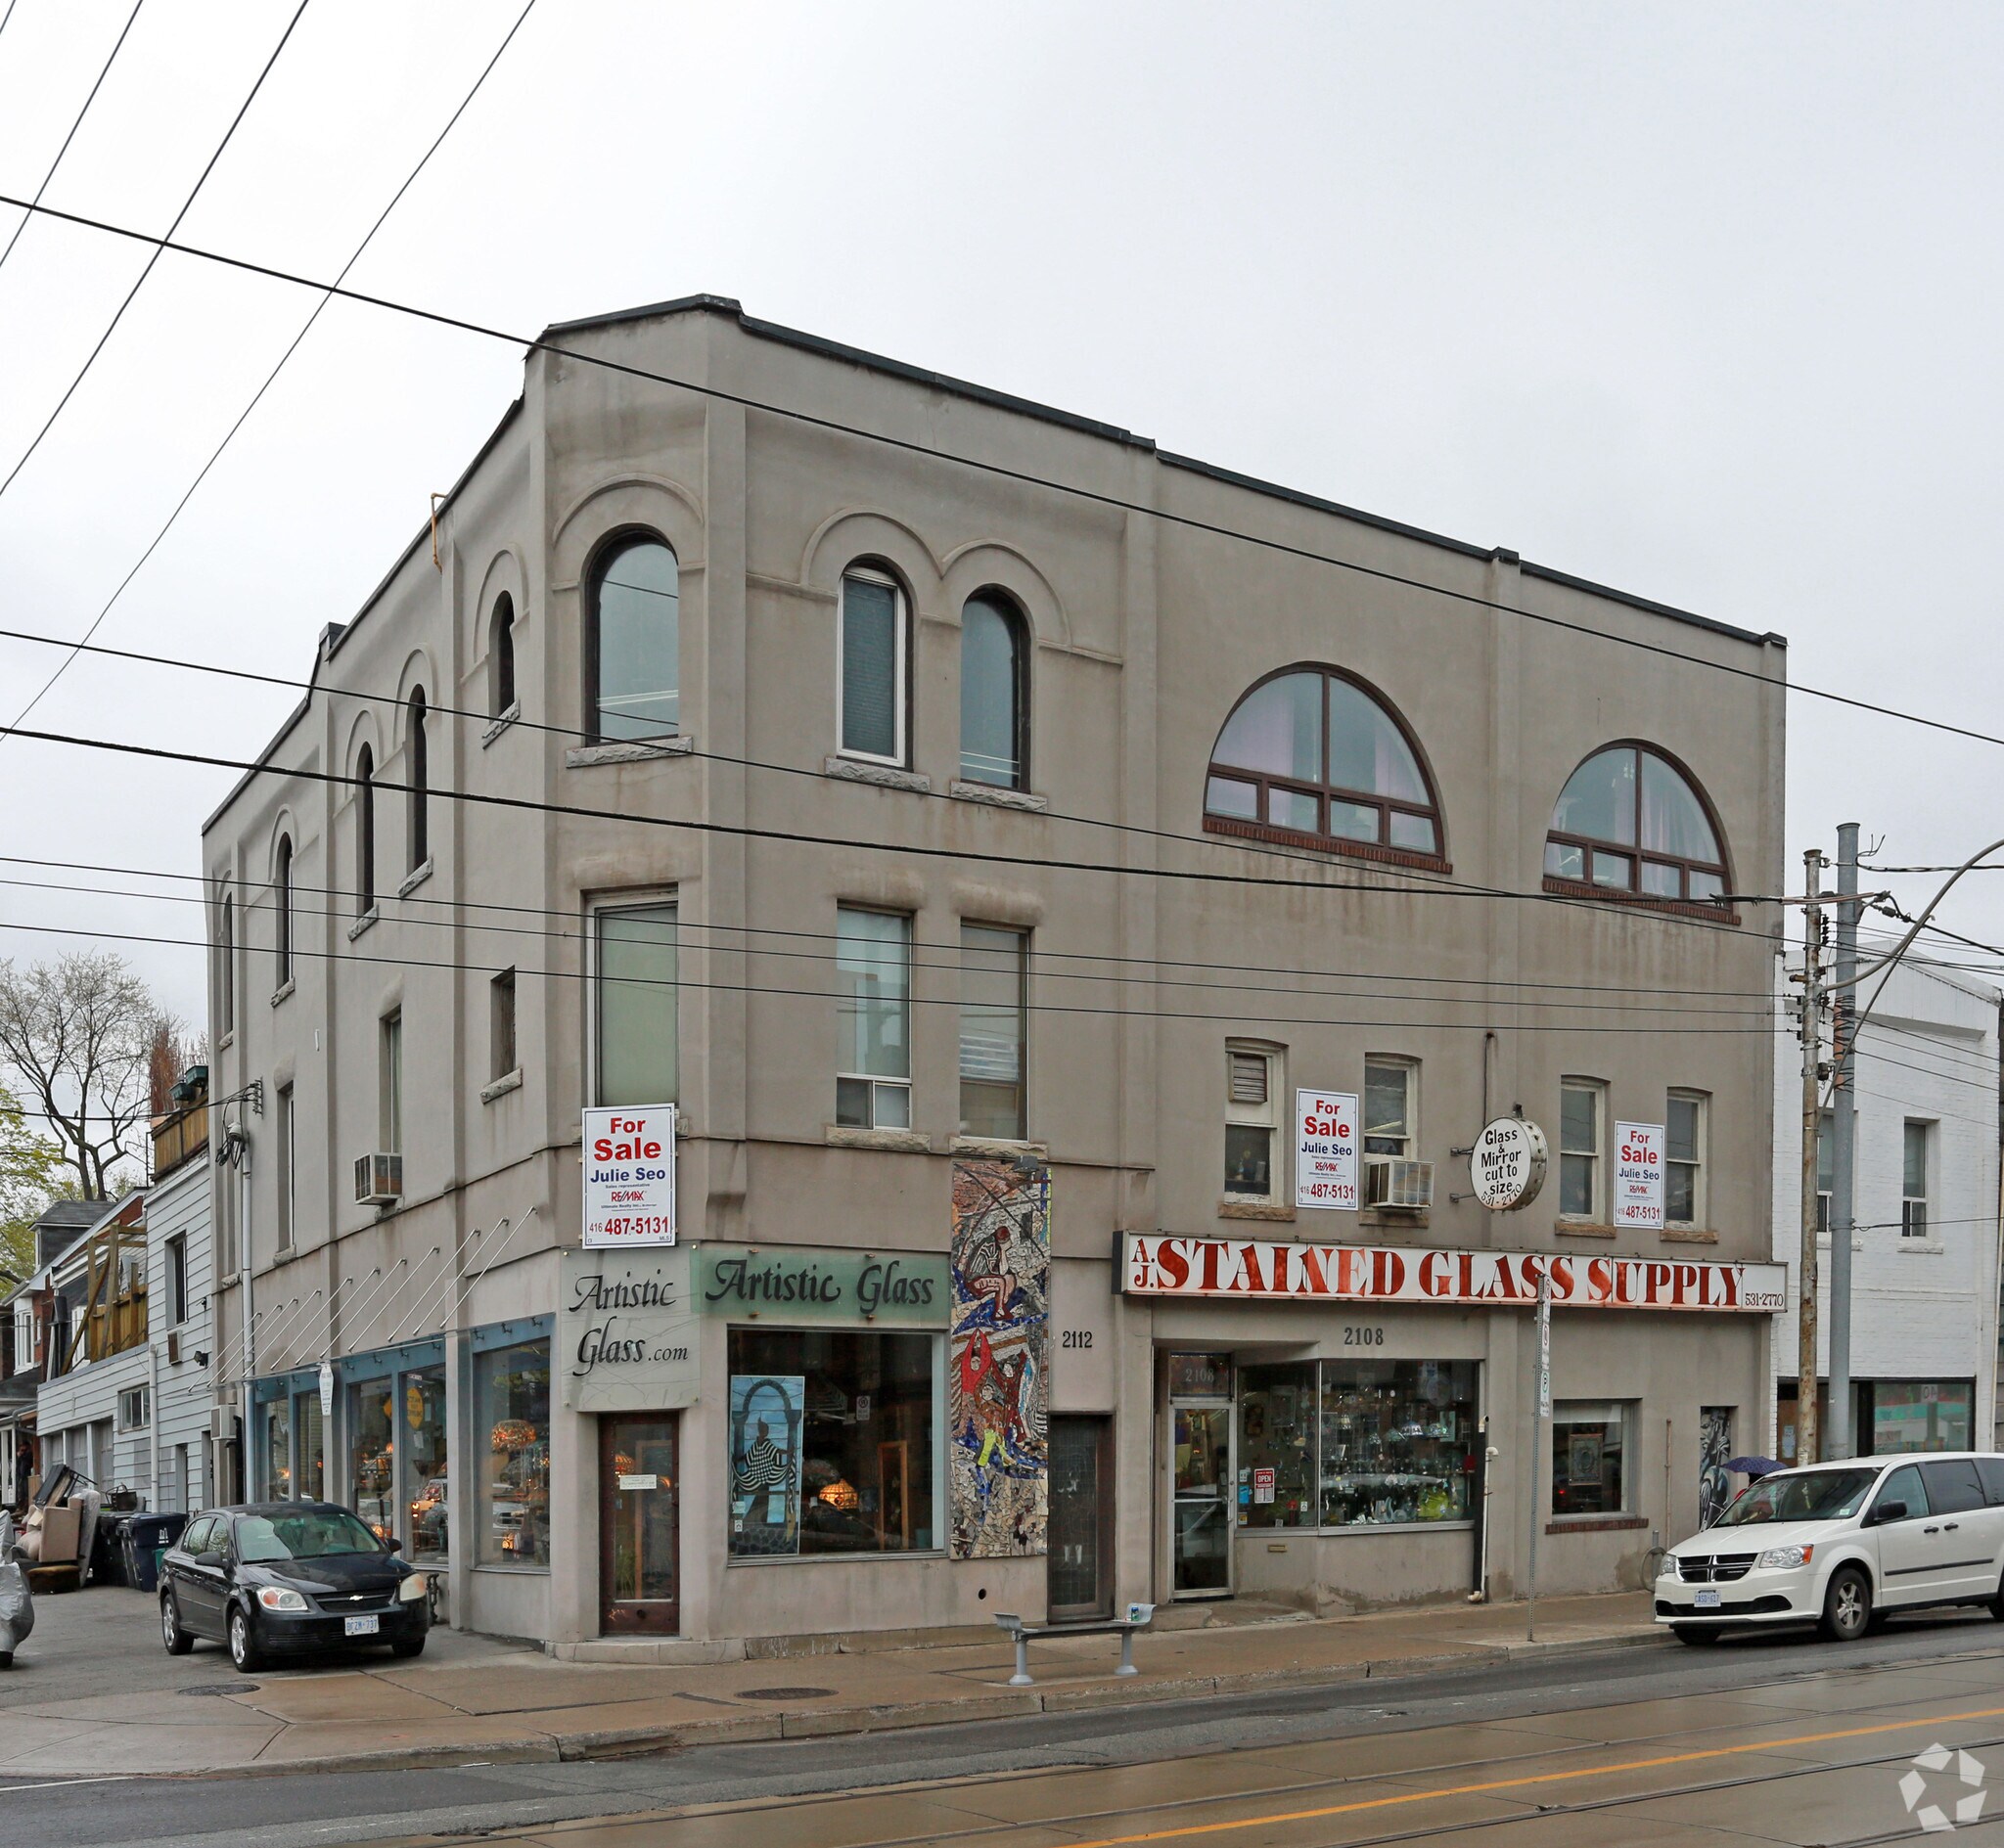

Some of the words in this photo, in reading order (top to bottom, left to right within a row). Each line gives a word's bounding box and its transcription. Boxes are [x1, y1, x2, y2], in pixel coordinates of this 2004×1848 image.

[1315, 1100, 1341, 1115] For
[611, 1117, 646, 1134] For
[1304, 1115, 1350, 1139] Sale
[1485, 1129, 1517, 1146] Glass
[1630, 1131, 1650, 1144] For
[594, 1137, 661, 1161] Sale
[1301, 1142, 1329, 1154] Julie
[1332, 1144, 1352, 1156] Seo
[1499, 1144, 1505, 1153] &
[1621, 1145, 1658, 1164] Sale
[1481, 1150, 1521, 1168] Mirror
[590, 1168, 630, 1183] Julie
[635, 1167, 665, 1181] Seo
[1485, 1165, 1503, 1181] cut
[1507, 1164, 1518, 1177] to
[1619, 1167, 1640, 1179] Julie
[1643, 1169, 1660, 1180] Seo
[611, 1190, 644, 1202] RE/MAX
[1311, 1183, 1354, 1199] 487-5131
[1490, 1181, 1513, 1195] size
[1625, 1205, 1660, 1220] 487-5131
[589, 1222, 603, 1233] 416
[605, 1216, 668, 1235] 487-5131
[1157, 1238, 1405, 1297] STAINED
[1419, 1250, 1575, 1301] GLASS
[1587, 1258, 1746, 1307] SUPPLY
[569, 1269, 677, 1313] Artistic
[706, 1260, 841, 1303] Artistic
[856, 1260, 934, 1315] Glass
[1063, 1330, 1092, 1348] 2112
[1344, 1327, 1384, 1345] 2108
[1185, 1369, 1214, 1383] 2108
